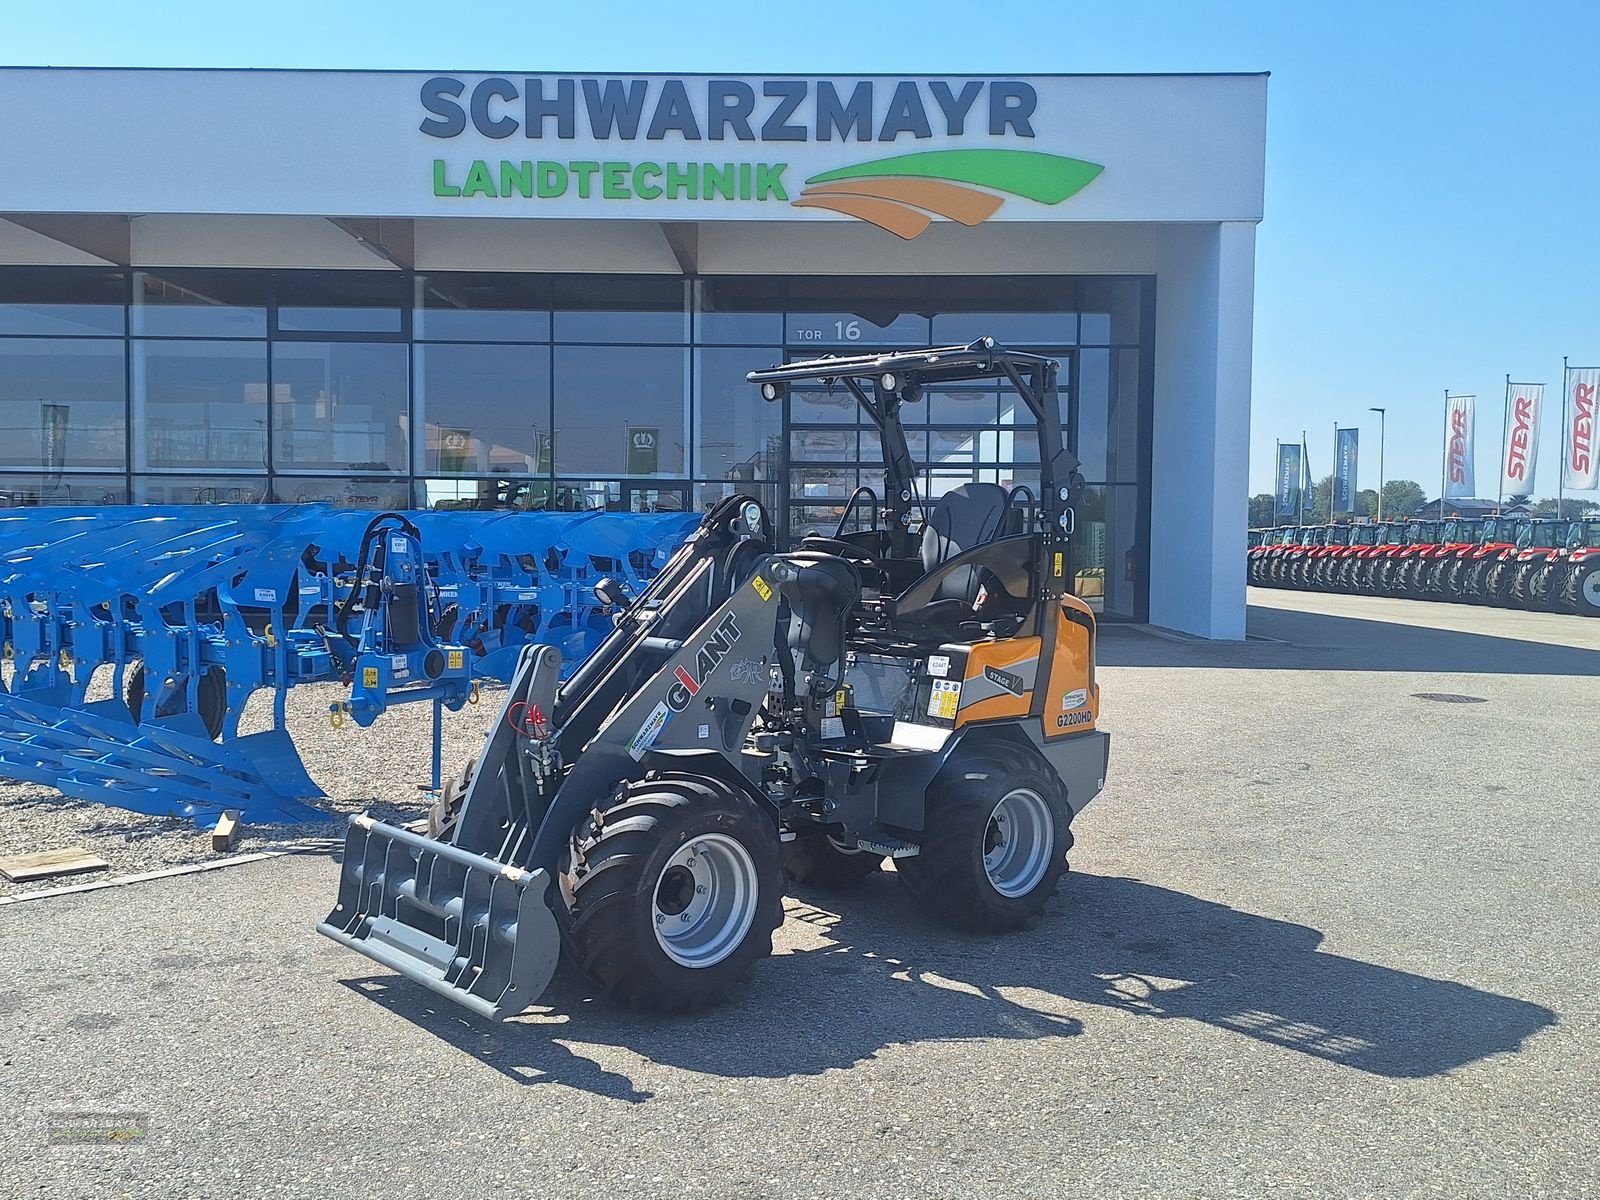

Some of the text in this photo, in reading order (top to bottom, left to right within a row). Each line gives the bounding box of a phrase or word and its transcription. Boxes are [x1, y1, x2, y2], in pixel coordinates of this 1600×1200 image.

[419, 77, 1037, 142] SCHWARZMAYR
[433, 159, 789, 201] LANDTECHNIK
[797, 321, 861, 340] TOR 16
[1450, 409, 1467, 486] STEYR
[1507, 397, 1532, 481] STEYR
[1573, 383, 1595, 476] STEYR
[666, 610, 742, 713] GIANT
[990, 671, 1021, 689] STAGE V
[631, 711, 662, 750] SCHWARZMAYR
[1057, 711, 1092, 728] G2200HD
